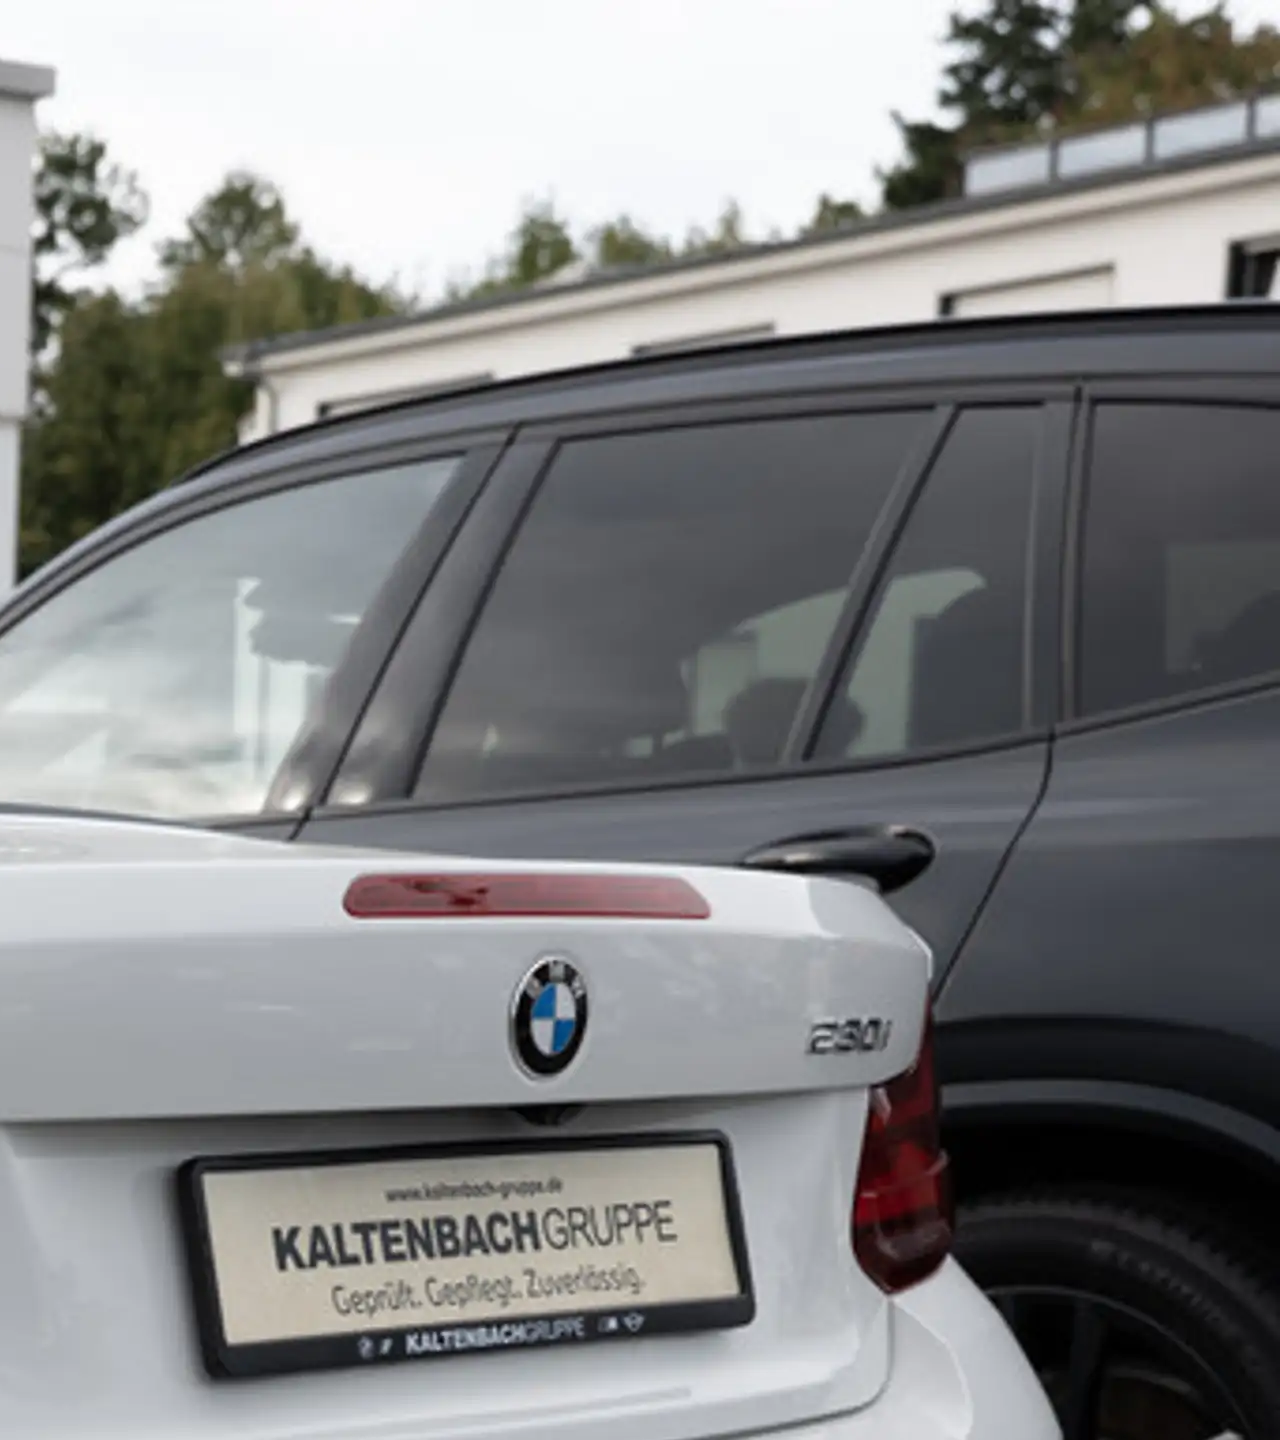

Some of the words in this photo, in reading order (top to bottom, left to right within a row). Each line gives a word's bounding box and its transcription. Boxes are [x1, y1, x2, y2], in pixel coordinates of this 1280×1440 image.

[805, 1017, 890, 1055] 230i
[272, 1200, 678, 1271] KALTENBACHGRUPPE
[331, 1285, 422, 1317] Geprüft.
[426, 1275, 522, 1308] Gepflegt.
[524, 1263, 645, 1297] Zuverlässig.
[405, 1316, 585, 1354] KALTENBACHGRUPPE
